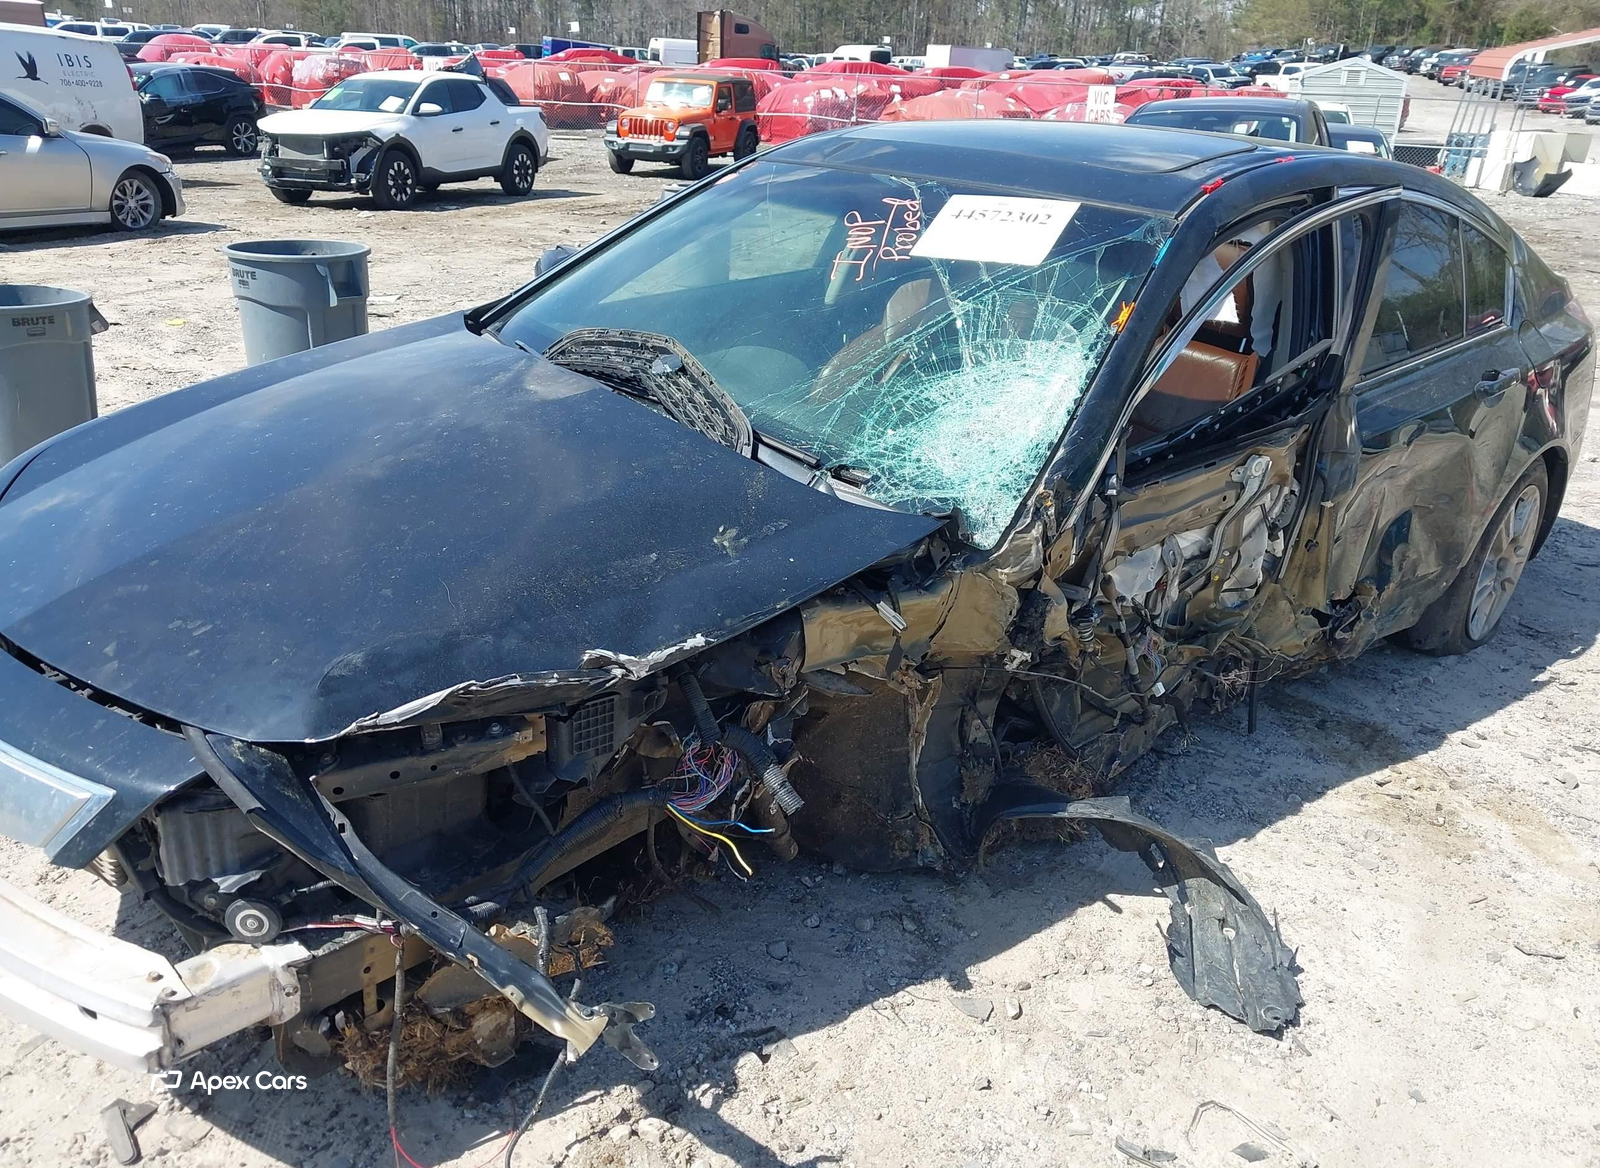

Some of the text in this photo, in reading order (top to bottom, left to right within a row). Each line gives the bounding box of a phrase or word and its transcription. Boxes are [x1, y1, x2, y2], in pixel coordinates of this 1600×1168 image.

[57, 53, 92, 68] IBIS
[1094, 91, 1110, 105] VIC
[1088, 109, 1111, 123] CARS
[951, 208, 1052, 225] 44572302
[231, 267, 258, 280] BRUTE
[12, 315, 55, 327] BRUTE
